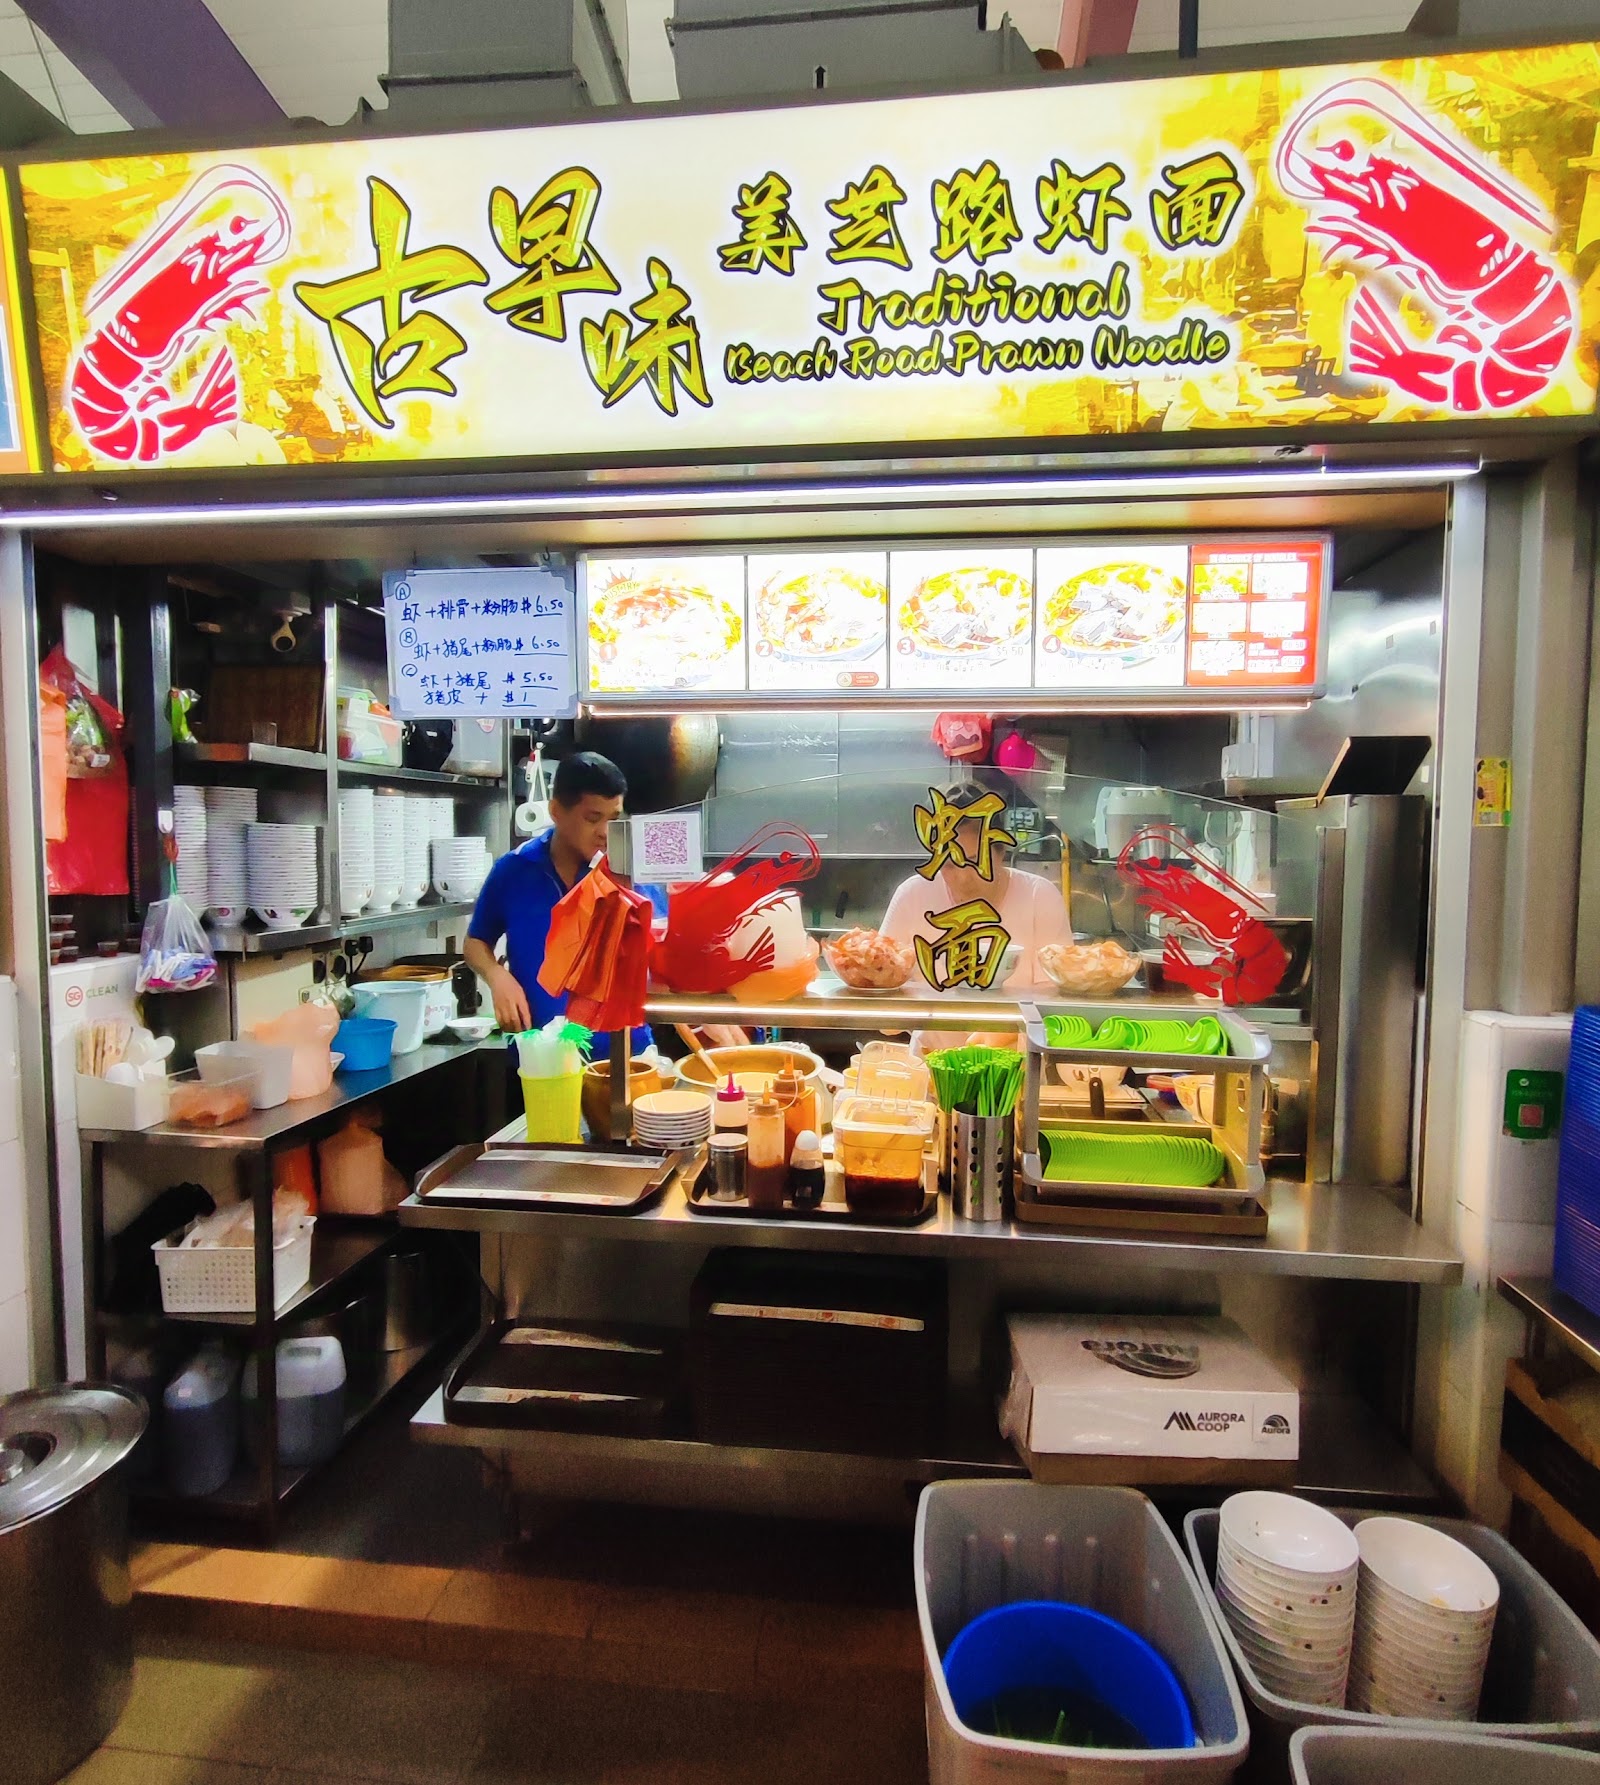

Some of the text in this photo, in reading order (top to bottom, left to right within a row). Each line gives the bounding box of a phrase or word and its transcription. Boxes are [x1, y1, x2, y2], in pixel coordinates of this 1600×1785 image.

[294, 166, 713, 429] 古早味
[817, 261, 1130, 336] Traditional
[723, 317, 1230, 385] Beach Road Prawn Noodle
[996, 646, 1024, 656] $550
[913, 787, 1018, 992] 虾面
[86, 984, 119, 998] CLEAN
[1196, 1422, 1230, 1432] COOP
[1197, 1412, 1291, 1434] AURORA Aurora
